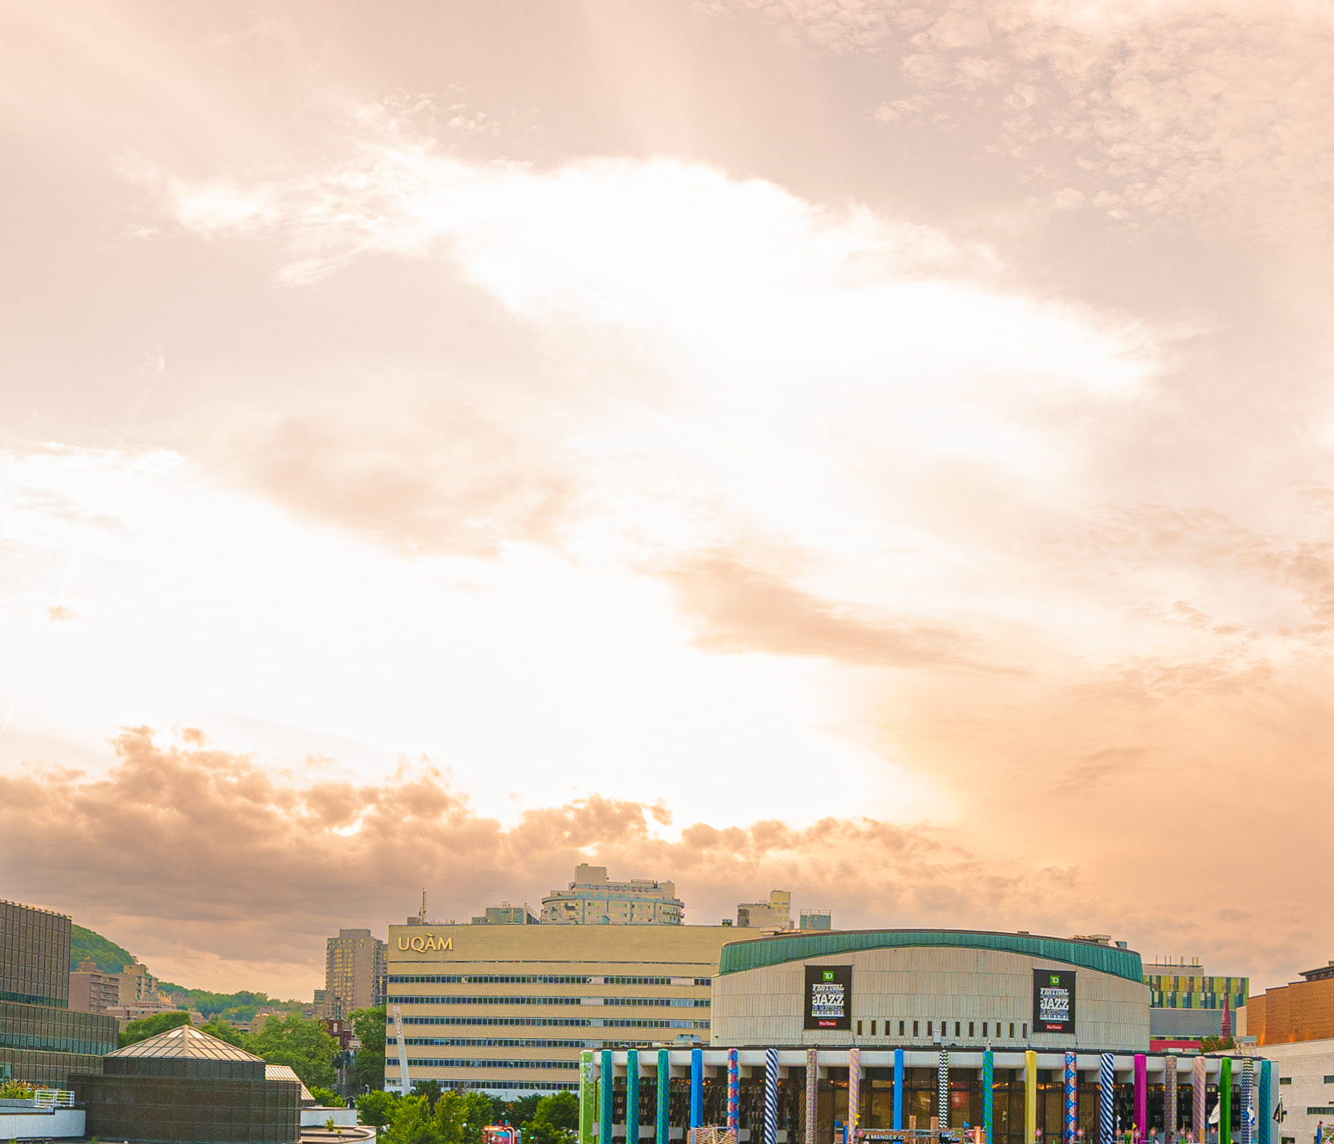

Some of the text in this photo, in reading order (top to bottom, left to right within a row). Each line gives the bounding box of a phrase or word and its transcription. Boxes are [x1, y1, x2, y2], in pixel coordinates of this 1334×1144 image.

[397, 932, 454, 953] UQÀM
[812, 983, 844, 991] FESTIVAL
[812, 994, 844, 1006] JAZZ
[1040, 998, 1069, 1010] JAZZ
